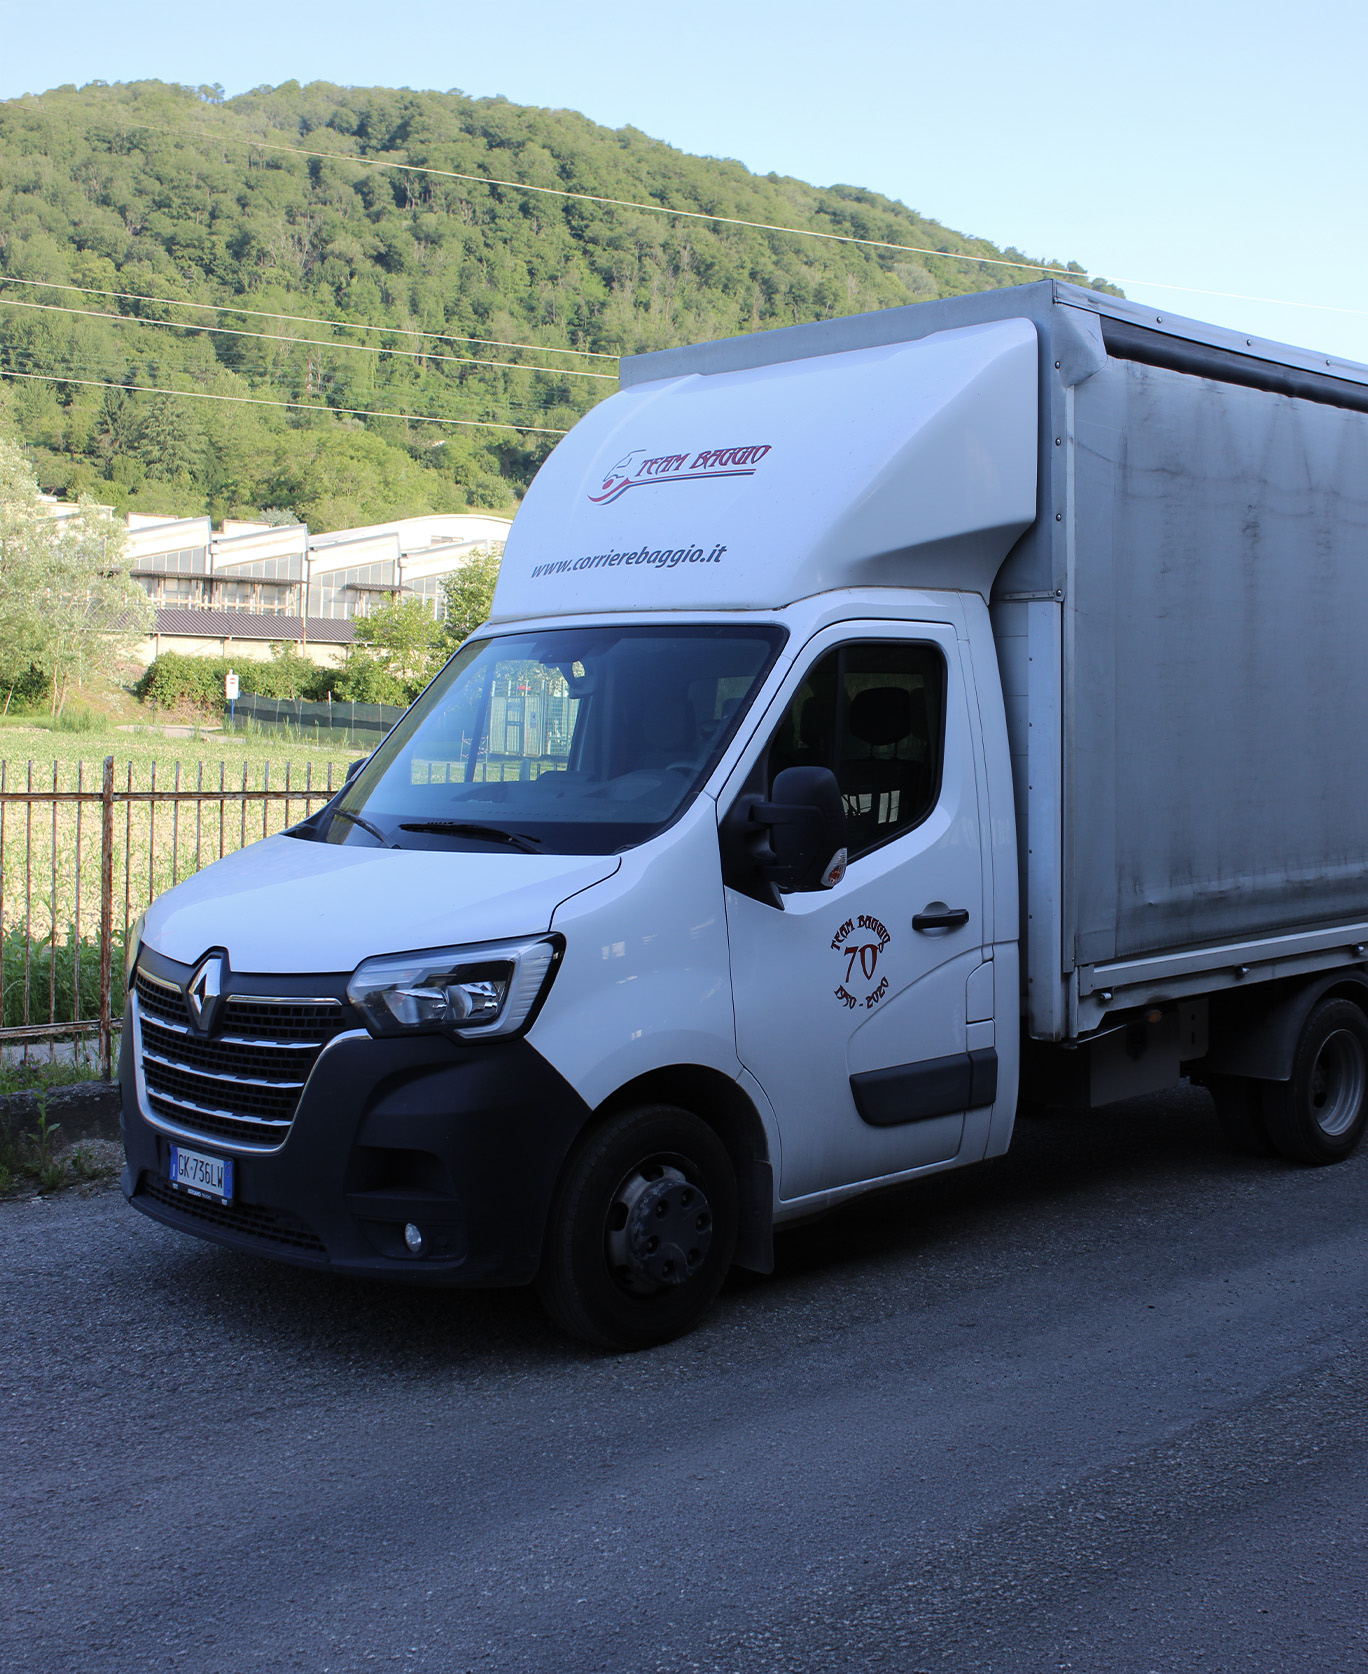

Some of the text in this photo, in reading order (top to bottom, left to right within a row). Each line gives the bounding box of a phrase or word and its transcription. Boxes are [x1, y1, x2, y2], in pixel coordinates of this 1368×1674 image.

[634, 444, 773, 477] TEAM BAGGIO
[530, 543, 728, 579] www.corrierebaggio.it
[830, 914, 891, 954] TEAM BAGGIO
[843, 943, 879, 983] 70
[833, 984, 858, 1010] 1950
[865, 976, 889, 1010] 2020
